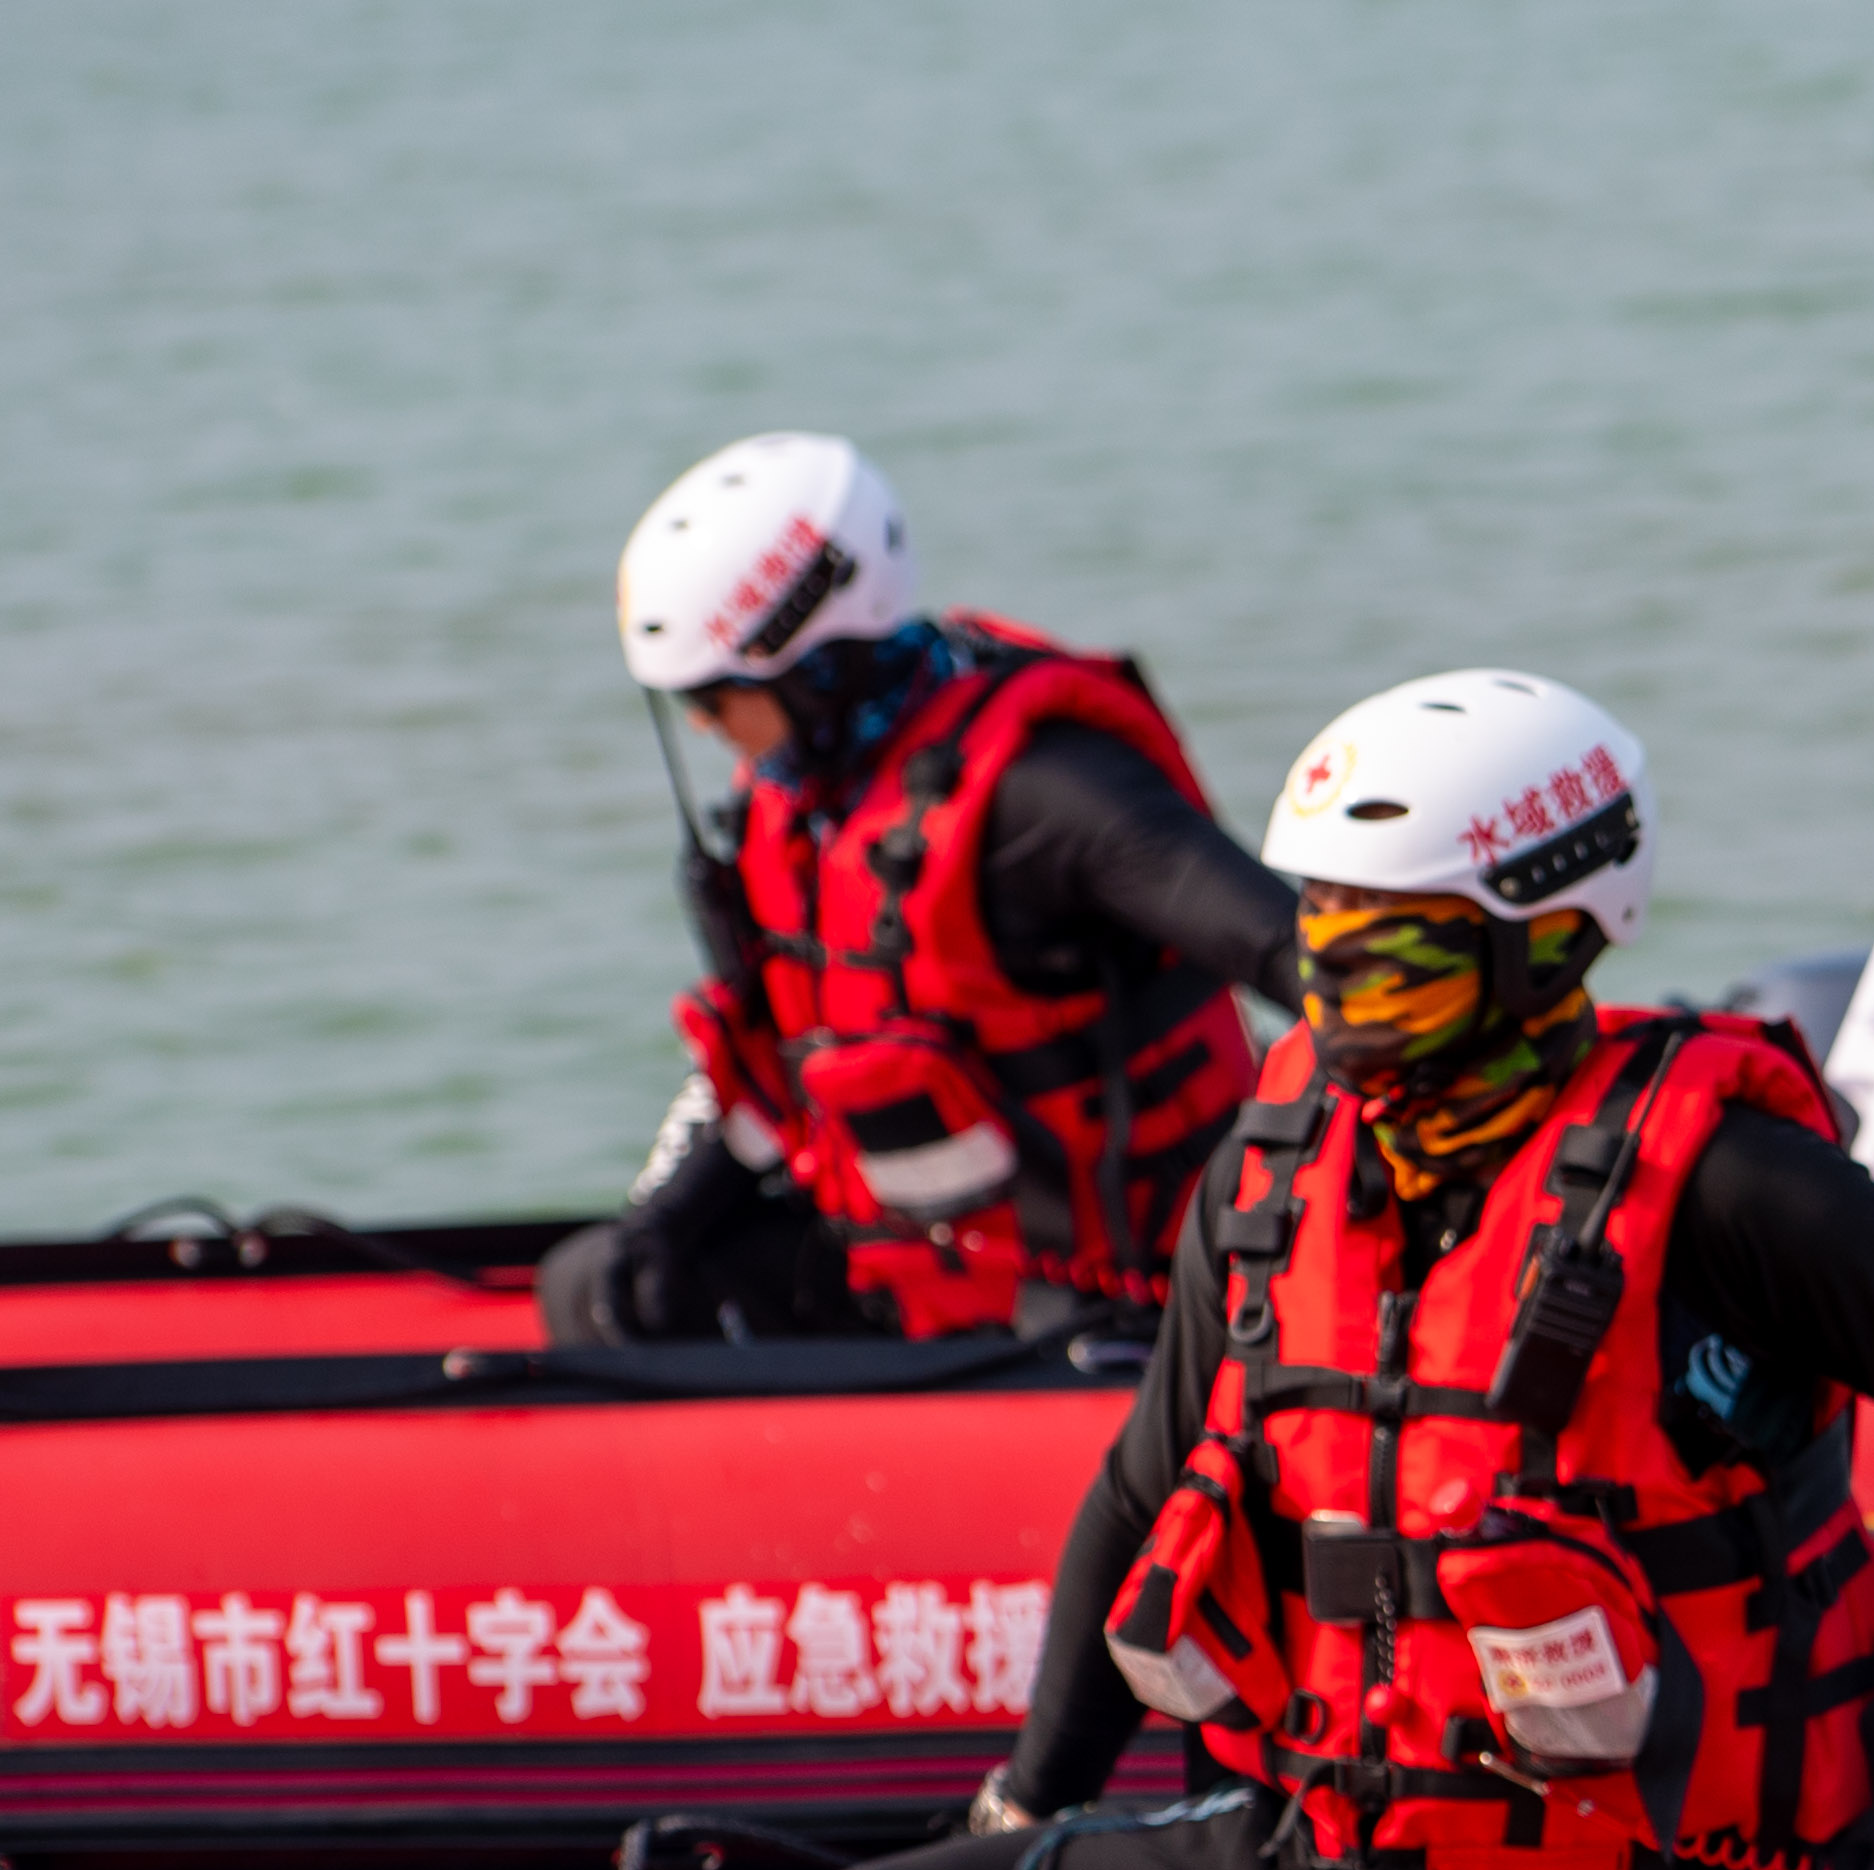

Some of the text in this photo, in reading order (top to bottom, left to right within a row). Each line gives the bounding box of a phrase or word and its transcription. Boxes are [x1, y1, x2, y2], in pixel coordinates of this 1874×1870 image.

[1457, 744, 1627, 864] 水域救援
[12, 1580, 1050, 1726] 无锡市红十字会 应急救援
